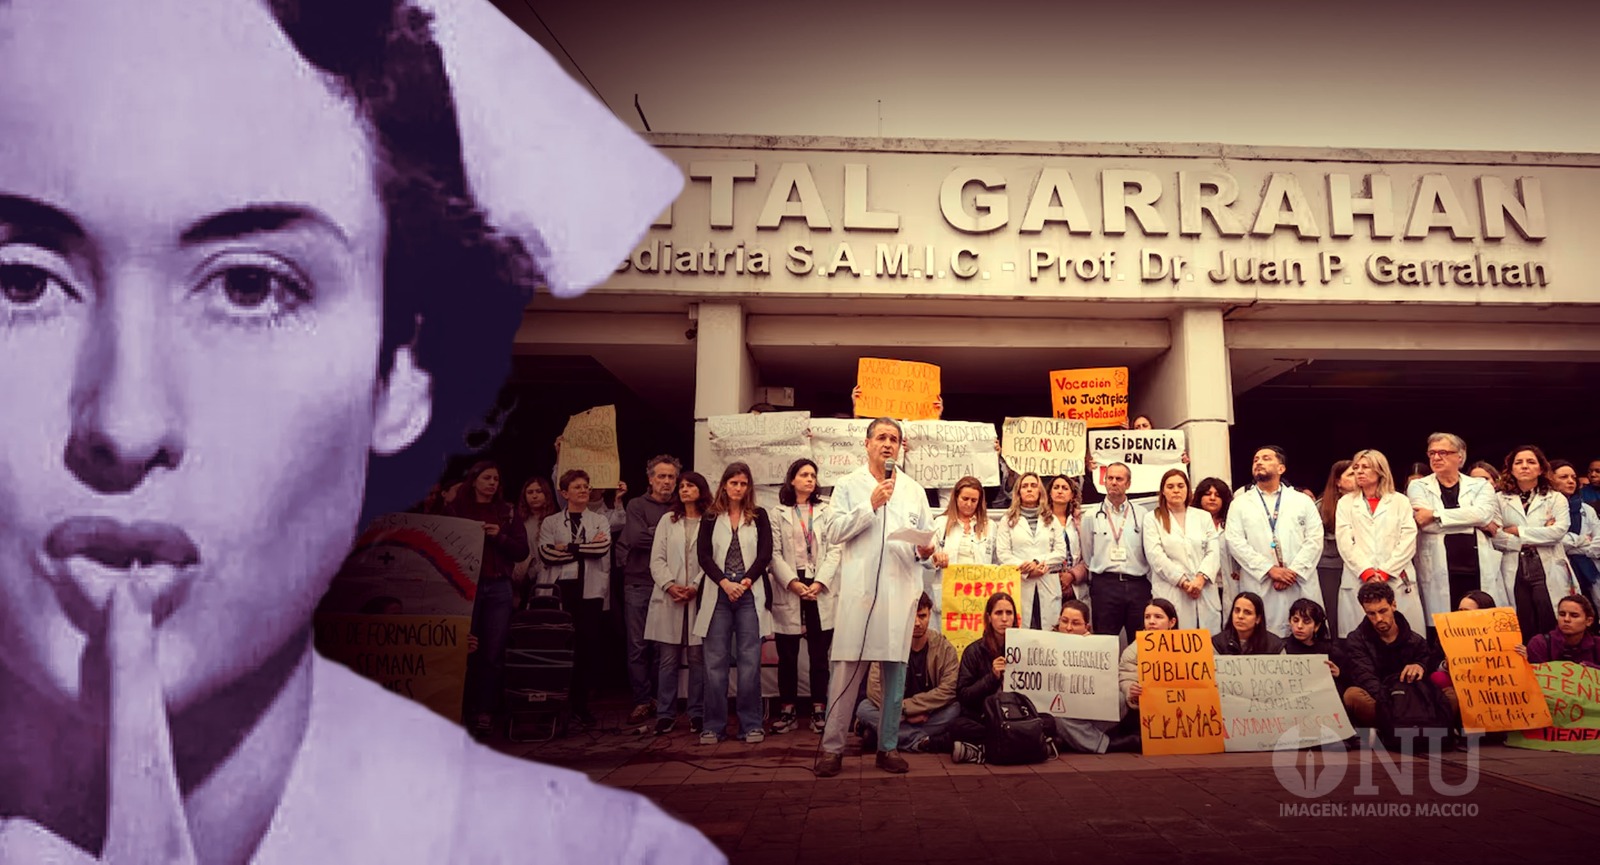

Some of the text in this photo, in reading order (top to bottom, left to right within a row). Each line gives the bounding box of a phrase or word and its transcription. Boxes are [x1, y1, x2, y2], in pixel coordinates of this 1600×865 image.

[651, 160, 1547, 241] TAL GARRAHAN
[613, 239, 771, 276] ediatria
[785, 241, 991, 280] S.A.M.I.C.
[1028, 246, 1125, 283] Prof.
[1140, 248, 1195, 284] Dr.
[1207, 249, 1306, 286] Juan
[1319, 250, 1352, 285] P.
[1365, 250, 1549, 288] Garrahan
[862, 376, 883, 390] PARA
[920, 381, 930, 394] LA
[1056, 376, 1111, 391] Vocación
[885, 398, 896, 413] DE
[1062, 395, 1077, 405] NO
[908, 424, 990, 442] SIN RESIDENTES
[1031, 420, 1043, 435] LO
[1045, 420, 1061, 436] QUE
[920, 444, 967, 460] NO HAY
[1013, 437, 1037, 452] PERO
[1039, 438, 1052, 453] NO
[1040, 458, 1057, 475] QUE
[1124, 453, 1143, 465] EN
[954, 581, 1014, 598] POBRES
[946, 612, 988, 632] ENF
[1144, 632, 1203, 653] SALUD
[1474, 636, 1505, 653] MAL
[1006, 646, 1022, 665] 80
[1027, 647, 1058, 667] HORAS
[1486, 655, 1516, 669] MAL
[1141, 659, 1212, 682] PÚBLICA
[1010, 668, 1042, 691] $3000
[1047, 672, 1065, 692] POR
[1250, 678, 1284, 697] PAGO
[1288, 678, 1312, 694] EL
[1488, 673, 1518, 686] MAL
[1166, 689, 1186, 703] EN
[1144, 707, 1222, 740] LLAMAS
